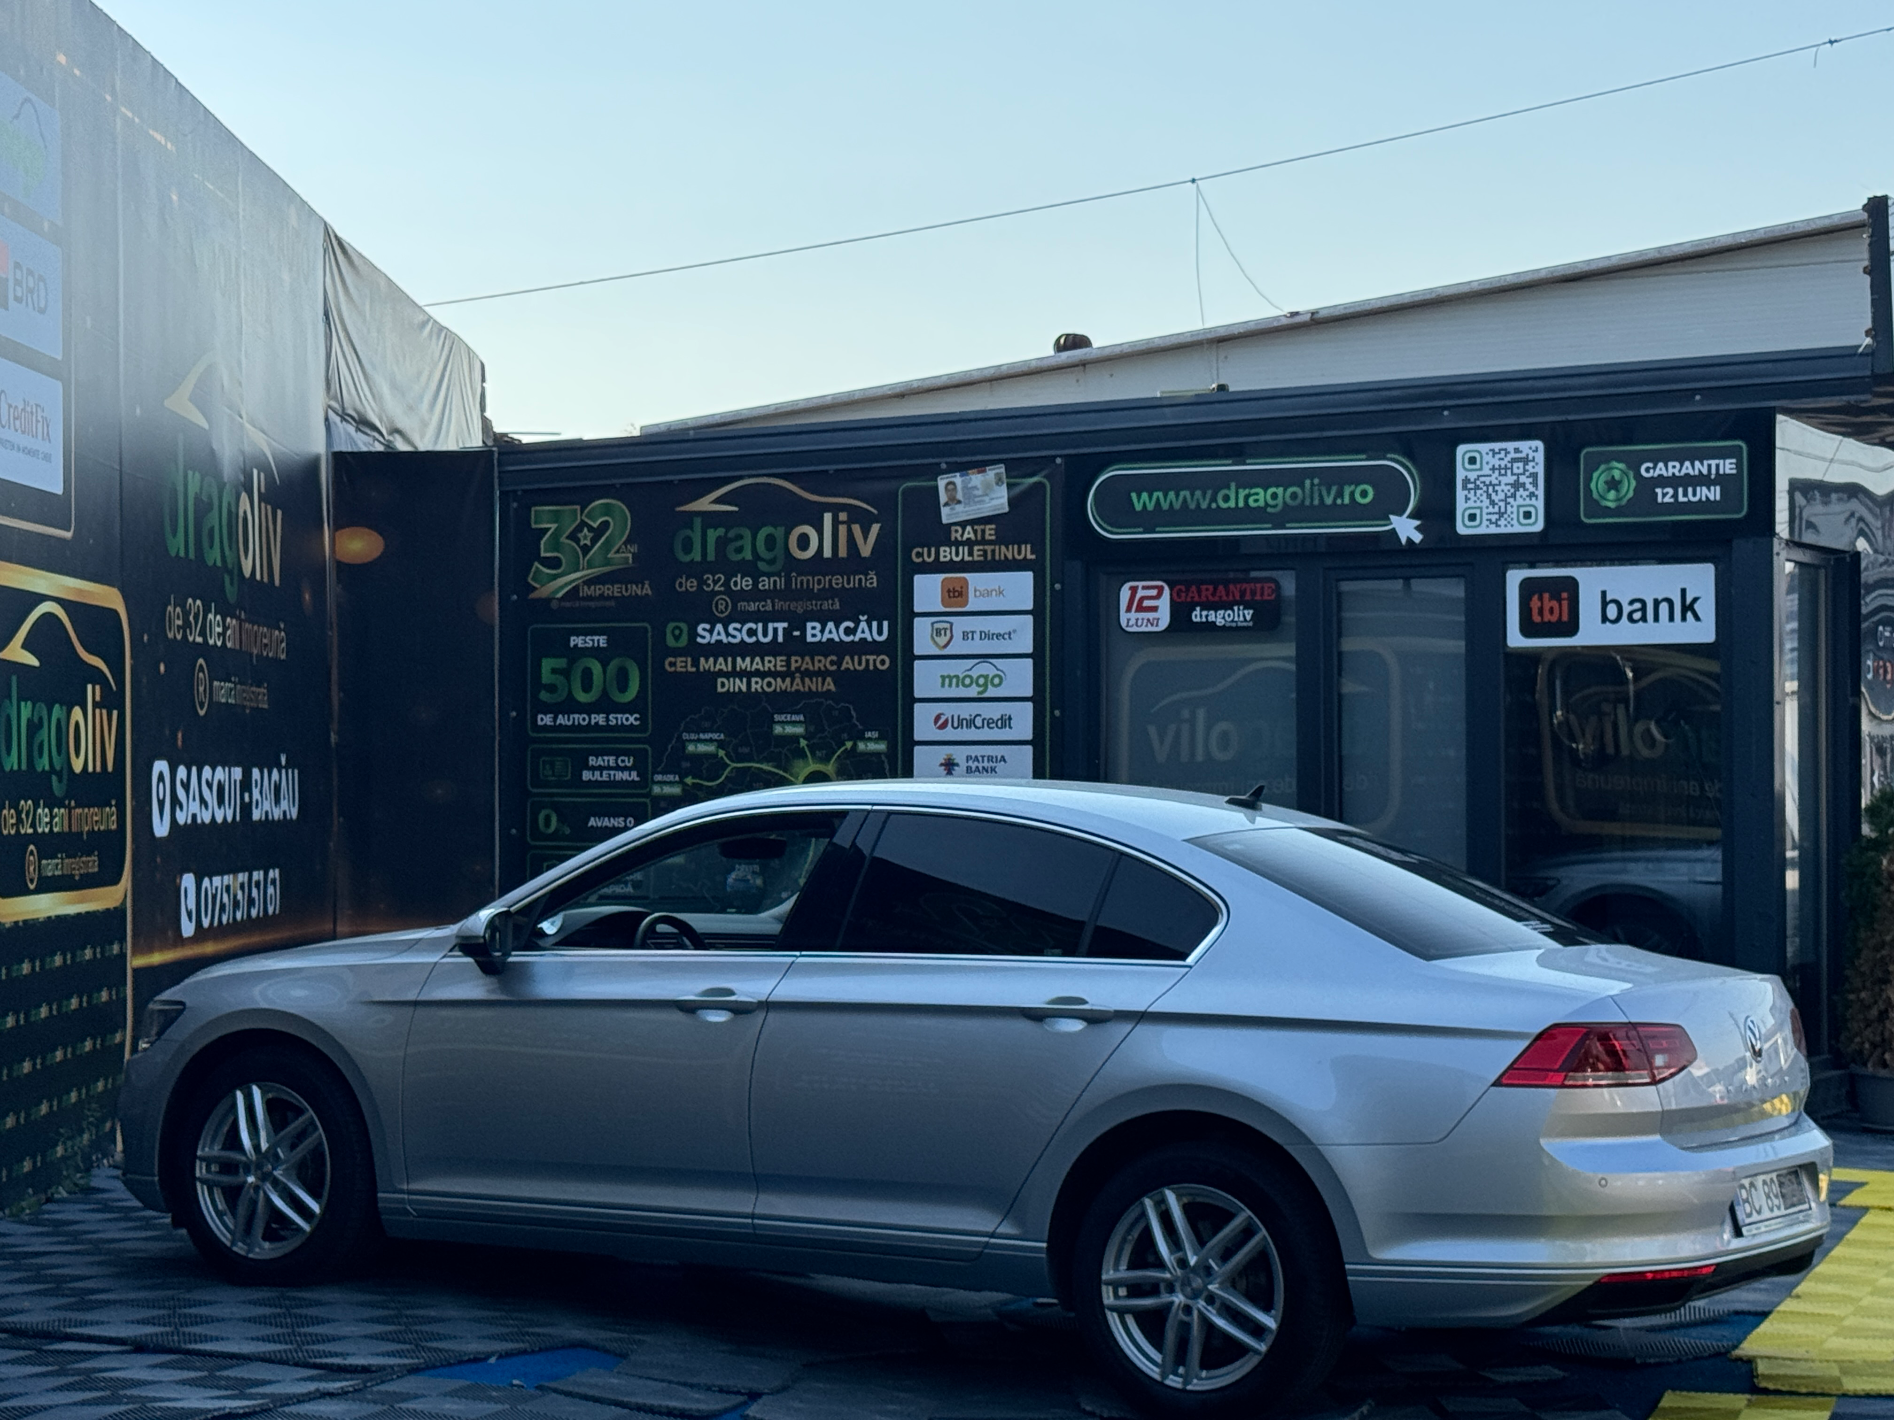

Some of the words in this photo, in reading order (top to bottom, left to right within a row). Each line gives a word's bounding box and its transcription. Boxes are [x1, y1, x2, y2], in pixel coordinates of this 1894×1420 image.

[13, 261, 48, 316] BRD
[0, 389, 52, 444] CreditFix
[1640, 458, 1737, 480] GARANȚIE
[1130, 478, 1374, 513] www.dragoliv.ro
[1655, 487, 1674, 503] 12
[1678, 485, 1720, 503] LUNI
[163, 433, 282, 604] dragoliv
[673, 512, 882, 573] dragoliv
[950, 524, 996, 542] RATE
[528, 499, 632, 588] 32
[619, 544, 638, 555] ANI
[911, 547, 935, 563] CU
[939, 544, 1036, 562] BULETINUL
[579, 581, 652, 598] ÎMPREUNĂ
[675, 574, 700, 593] de
[703, 574, 725, 591] 32
[730, 573, 754, 591] de
[758, 572, 786, 590] ani
[791, 570, 878, 593] împreună
[946, 587, 964, 599] tbi
[973, 586, 1006, 599] bank
[1125, 585, 1165, 614] 12
[737, 597, 773, 612] marcă
[774, 596, 840, 614] înregistrată
[1529, 592, 1569, 623] tbi
[1600, 588, 1702, 625] bank
[1125, 617, 1161, 628] LUNI
[1191, 605, 1254, 627] dragoliv
[165, 594, 183, 640] de
[186, 597, 203, 644] 32
[206, 602, 223, 647] de
[226, 608, 240, 651] ani
[240, 610, 287, 664] împreună
[696, 621, 788, 645] SASCUT
[806, 615, 889, 643] BACĂU
[935, 627, 948, 638] BT
[962, 631, 977, 641] BT
[569, 635, 608, 649] PESTE
[665, 658, 696, 673] CEL
[700, 657, 733, 672] MAI
[735, 656, 788, 672] MARE
[790, 656, 838, 671] PARC
[840, 655, 890, 671] AUTO
[538, 656, 640, 704] 500
[717, 677, 749, 693] DIN
[751, 674, 836, 693] ROMÂNIA
[939, 673, 1004, 696] mogo
[537, 714, 555, 726] DE
[556, 713, 589, 726] AUTO
[591, 713, 607, 726] PE
[608, 713, 641, 726] STOC
[951, 714, 1014, 731] UniCredit
[0, 674, 118, 798] dragoliv
[588, 756, 616, 768] RATE
[617, 755, 634, 768] CU
[965, 755, 1007, 764] PATRIA
[966, 765, 998, 774] BANK
[582, 770, 640, 781] BULETINUL
[175, 765, 243, 826] SASCUT
[252, 753, 299, 821] BACĂU
[1, 800, 17, 836] de
[19, 799, 34, 834] 32
[36, 799, 50, 834] de
[52, 799, 69, 833] ani
[70, 799, 117, 841] împreună
[587, 816, 625, 828] AVANS
[626, 816, 635, 828] 0
[1738, 1182, 1762, 1219] BC
